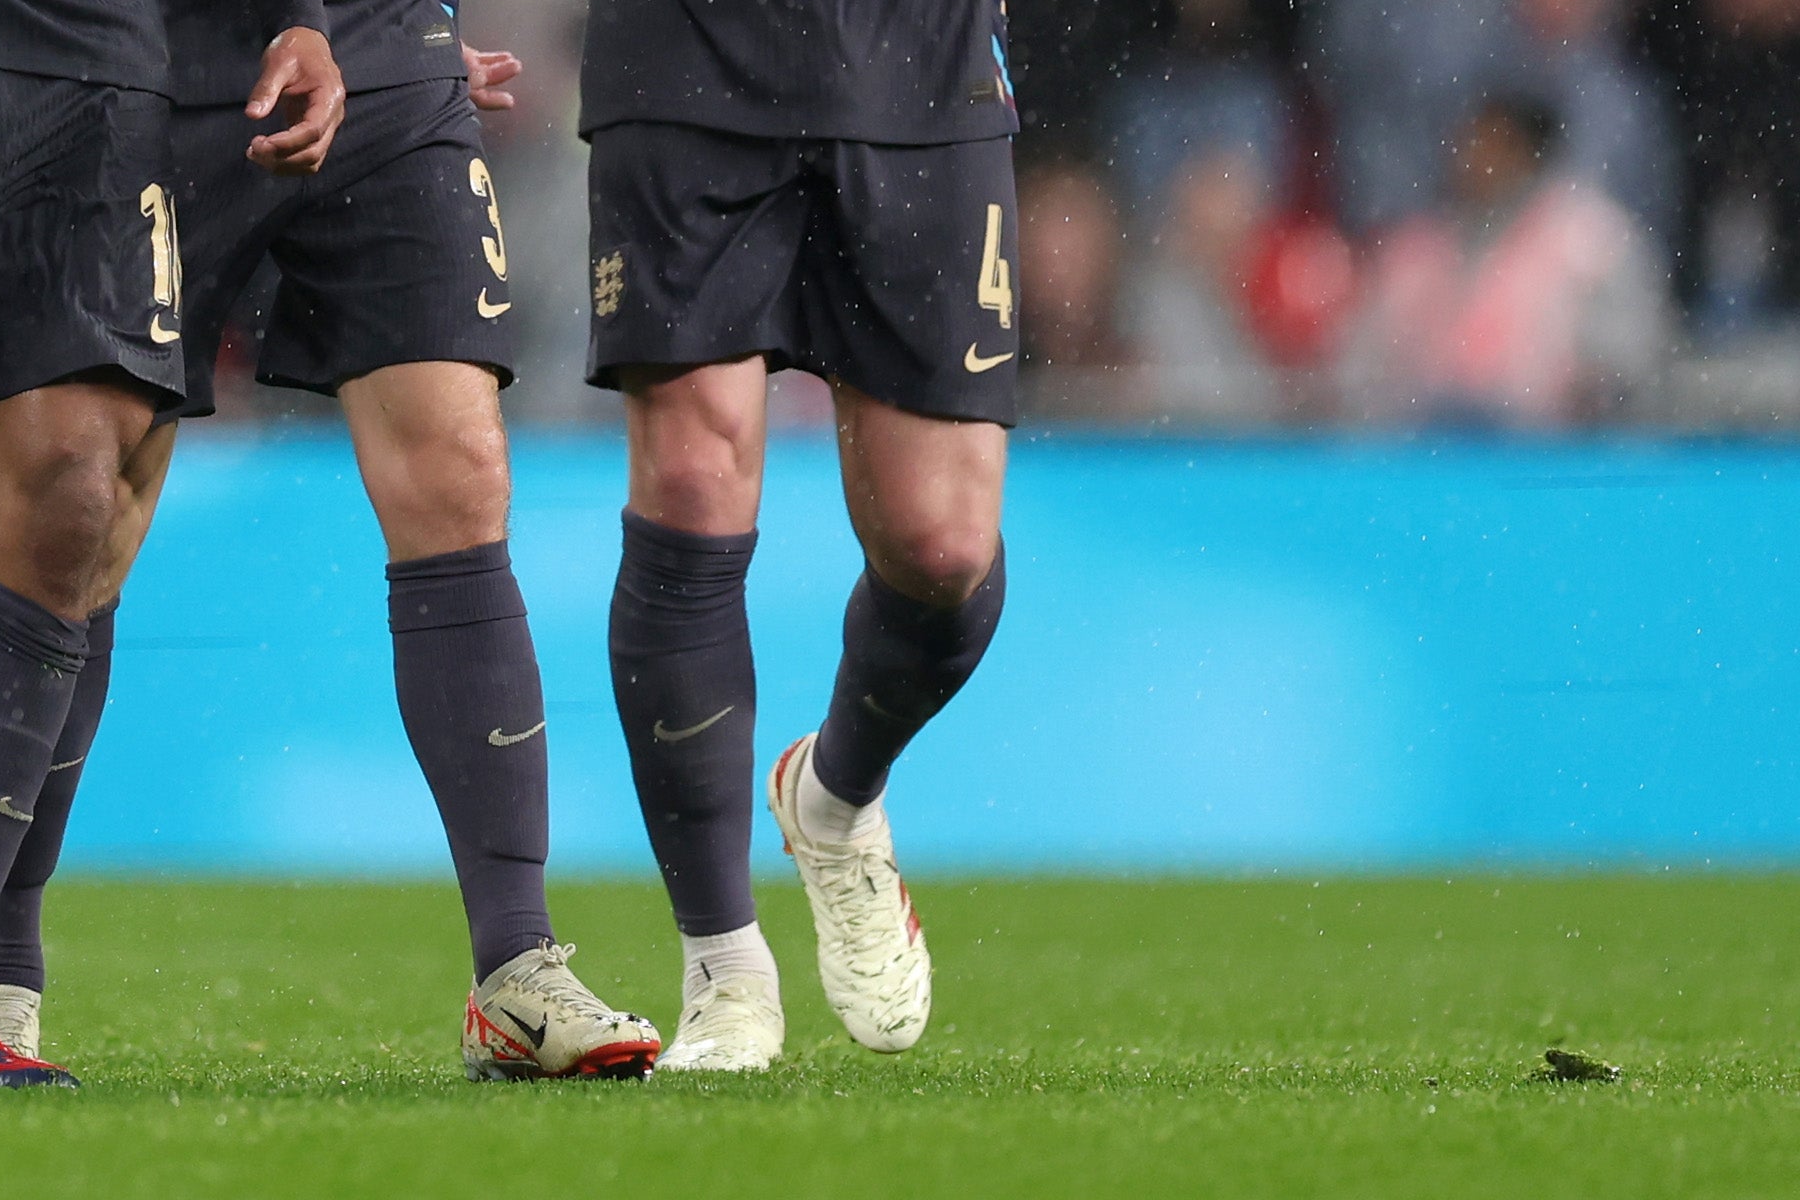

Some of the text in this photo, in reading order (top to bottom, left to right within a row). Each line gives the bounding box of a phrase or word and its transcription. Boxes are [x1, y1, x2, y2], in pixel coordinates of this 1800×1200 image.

[140, 182, 183, 319] 1
[469, 157, 508, 282] 3
[978, 203, 1013, 329] 4
